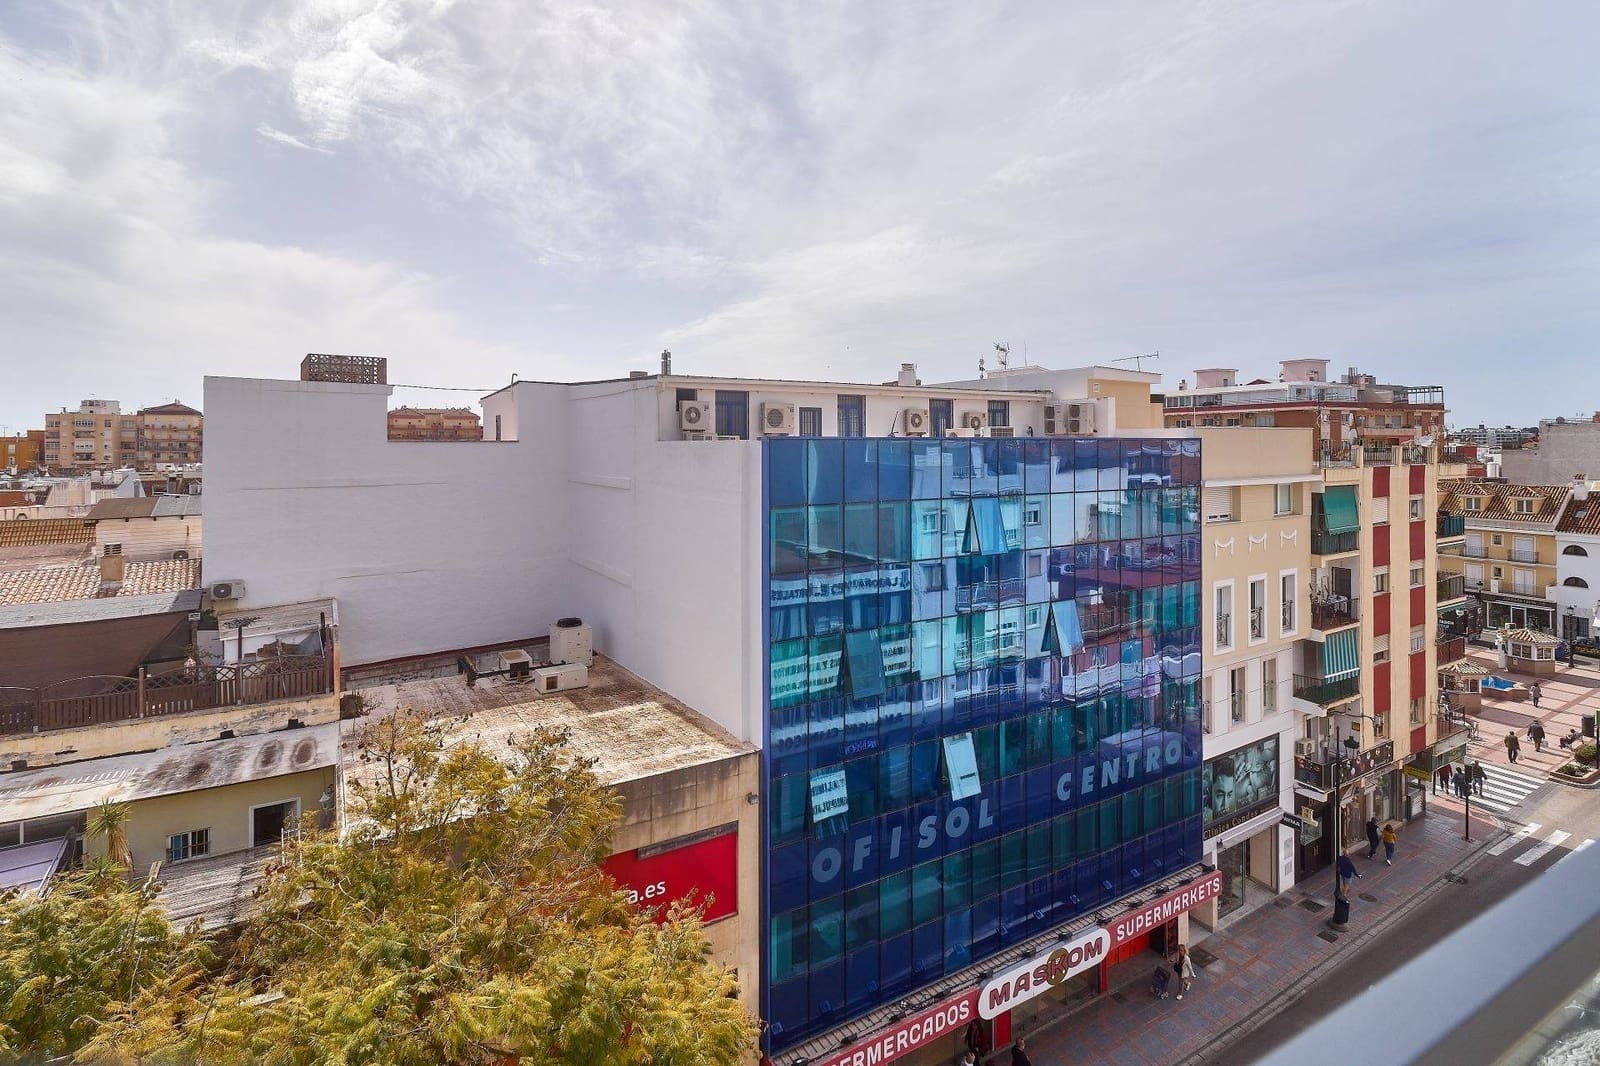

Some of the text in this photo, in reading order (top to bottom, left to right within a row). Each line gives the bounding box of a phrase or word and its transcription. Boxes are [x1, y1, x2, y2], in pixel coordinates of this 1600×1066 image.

[812, 740, 1182, 883] OFISOL CENTRO
[627, 881, 666, 904] a.es
[989, 937, 1103, 1010] MASKOM
[1117, 877, 1220, 942] SUPERMARKETS
